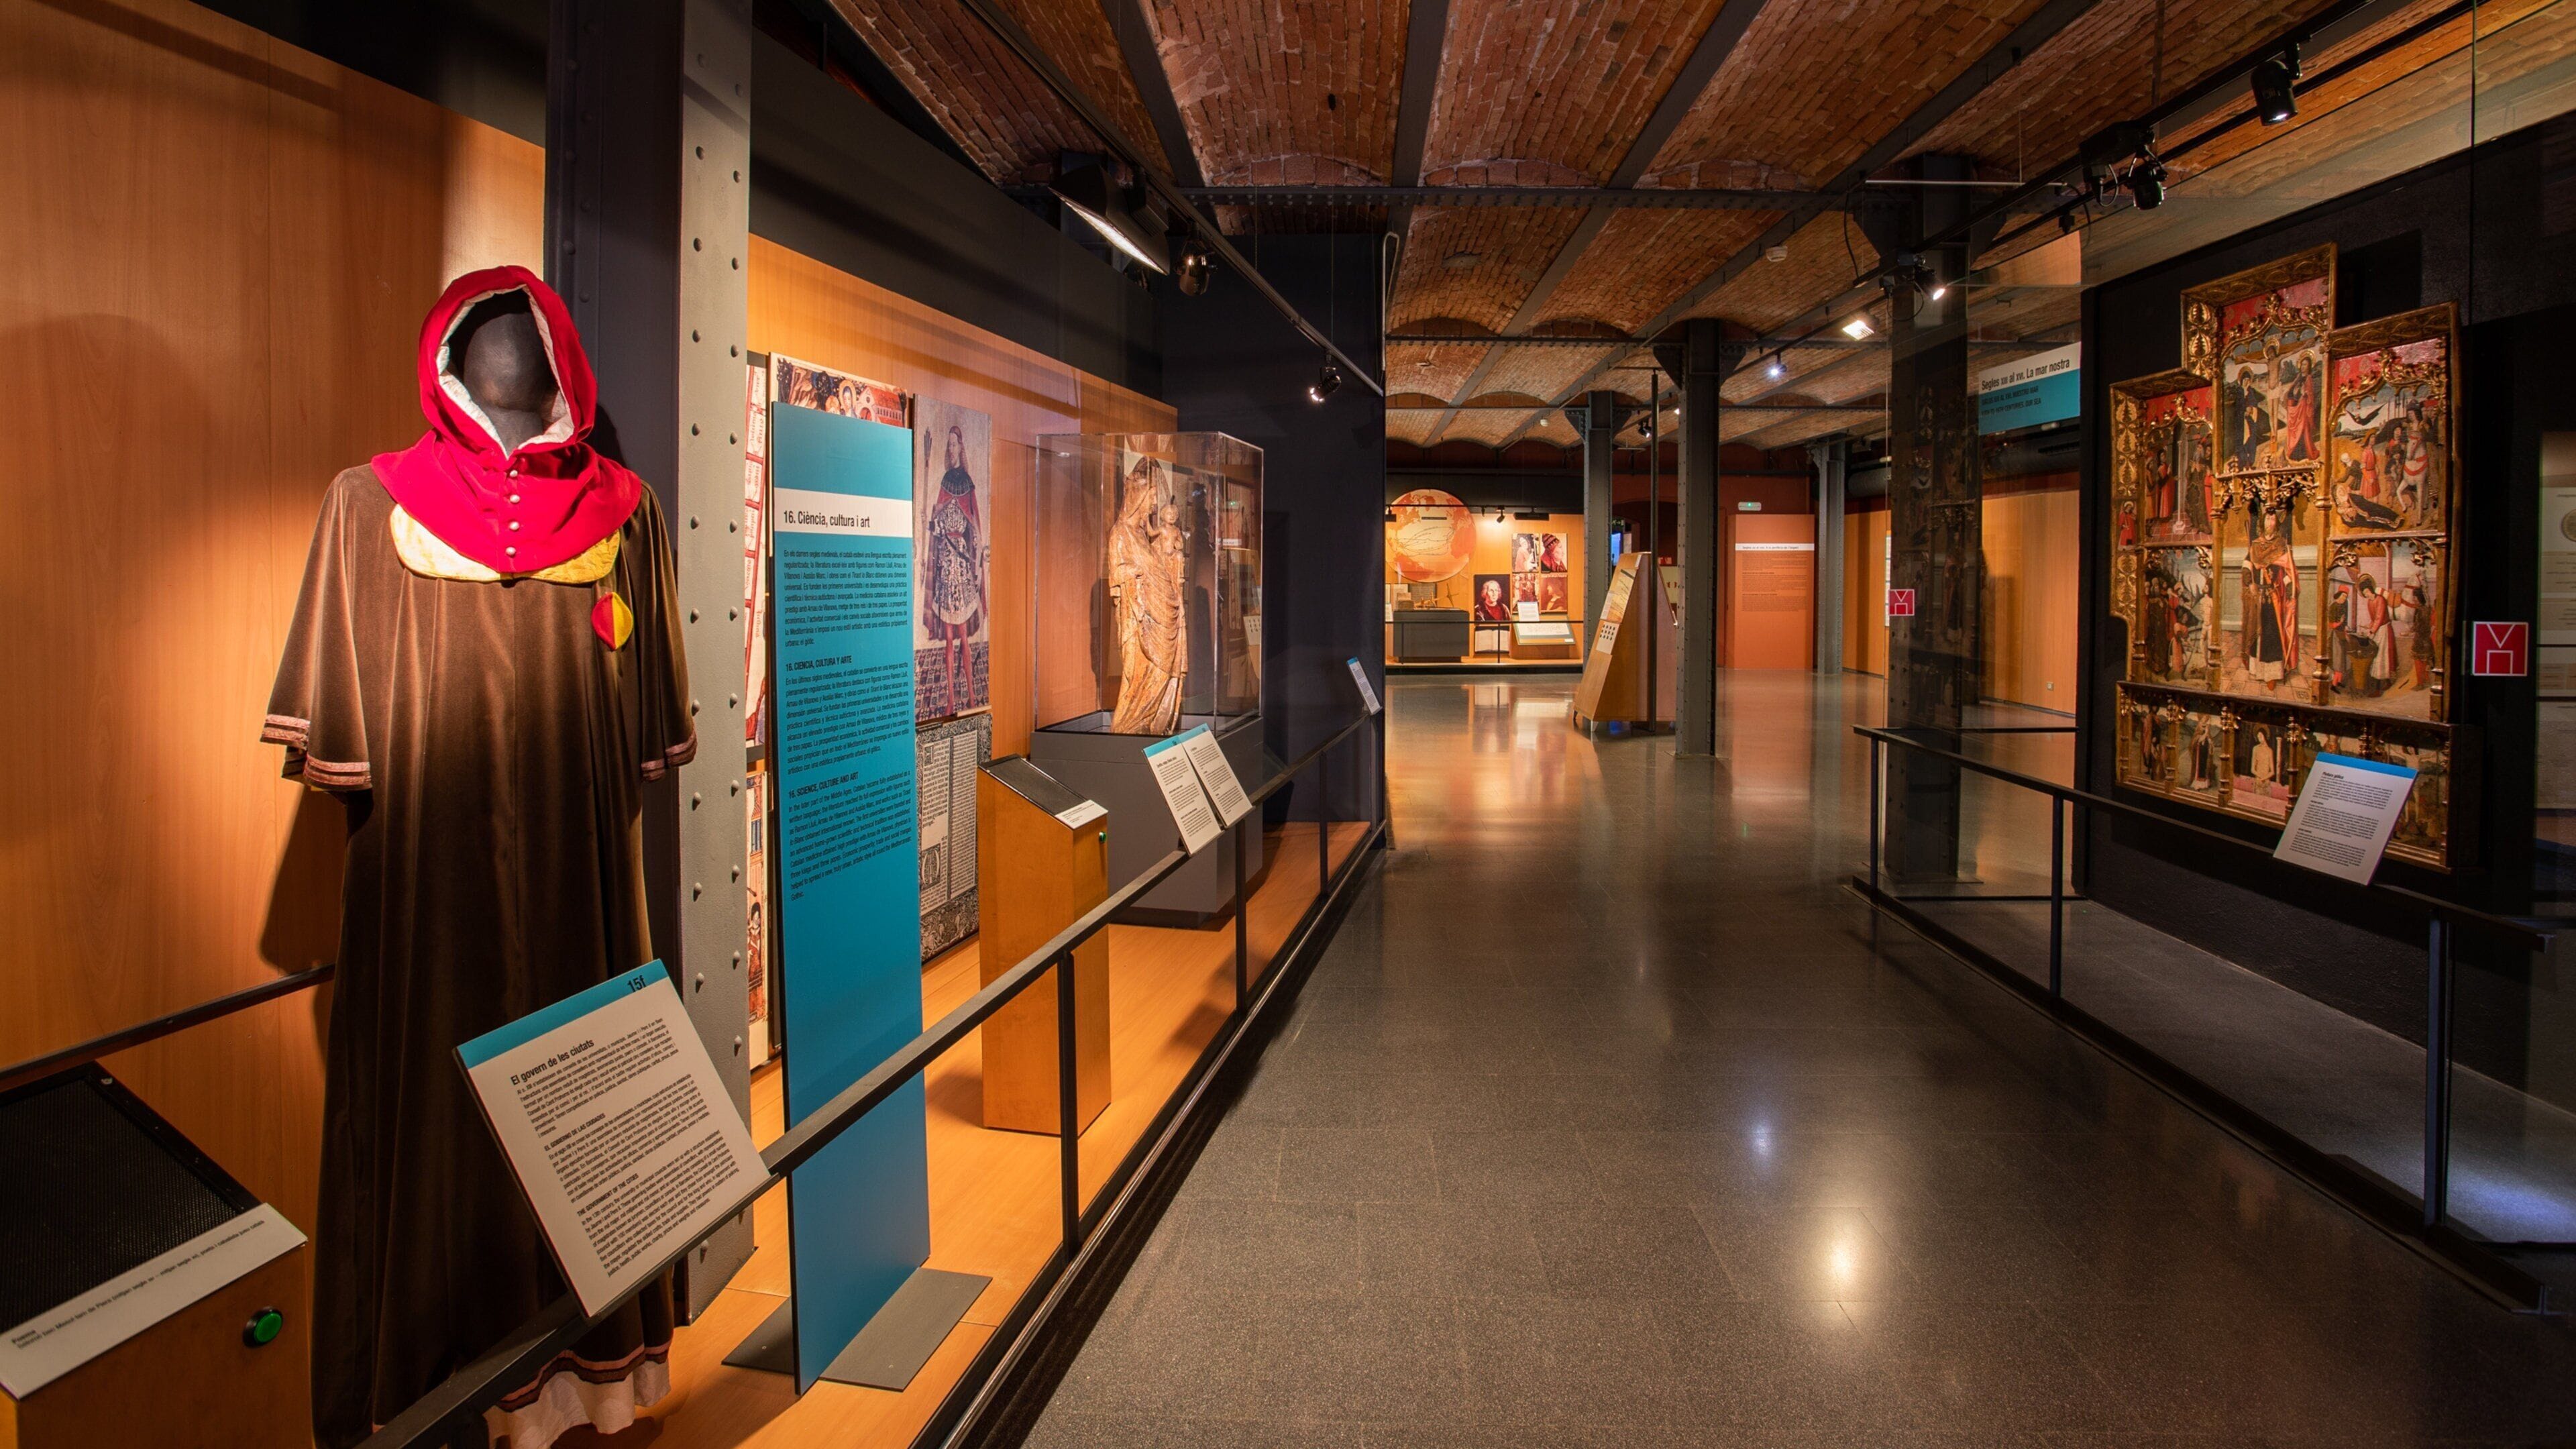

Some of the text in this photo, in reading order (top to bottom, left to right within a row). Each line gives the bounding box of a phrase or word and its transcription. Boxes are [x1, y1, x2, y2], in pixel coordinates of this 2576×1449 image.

[1982, 378, 1999, 390] Segles
[2009, 372, 2015, 383] al
[2026, 368, 2033, 378] La
[2035, 366, 2047, 376] mar
[2049, 359, 2070, 372] nostra
[784, 510, 870, 528] 16. Ciència, cultura i art
[815, 657, 835, 667] CULTURA
[840, 655, 851, 663] ARTE
[628, 975, 647, 994] 15f
[511, 1040, 594, 1085] El govern de les ciutats
